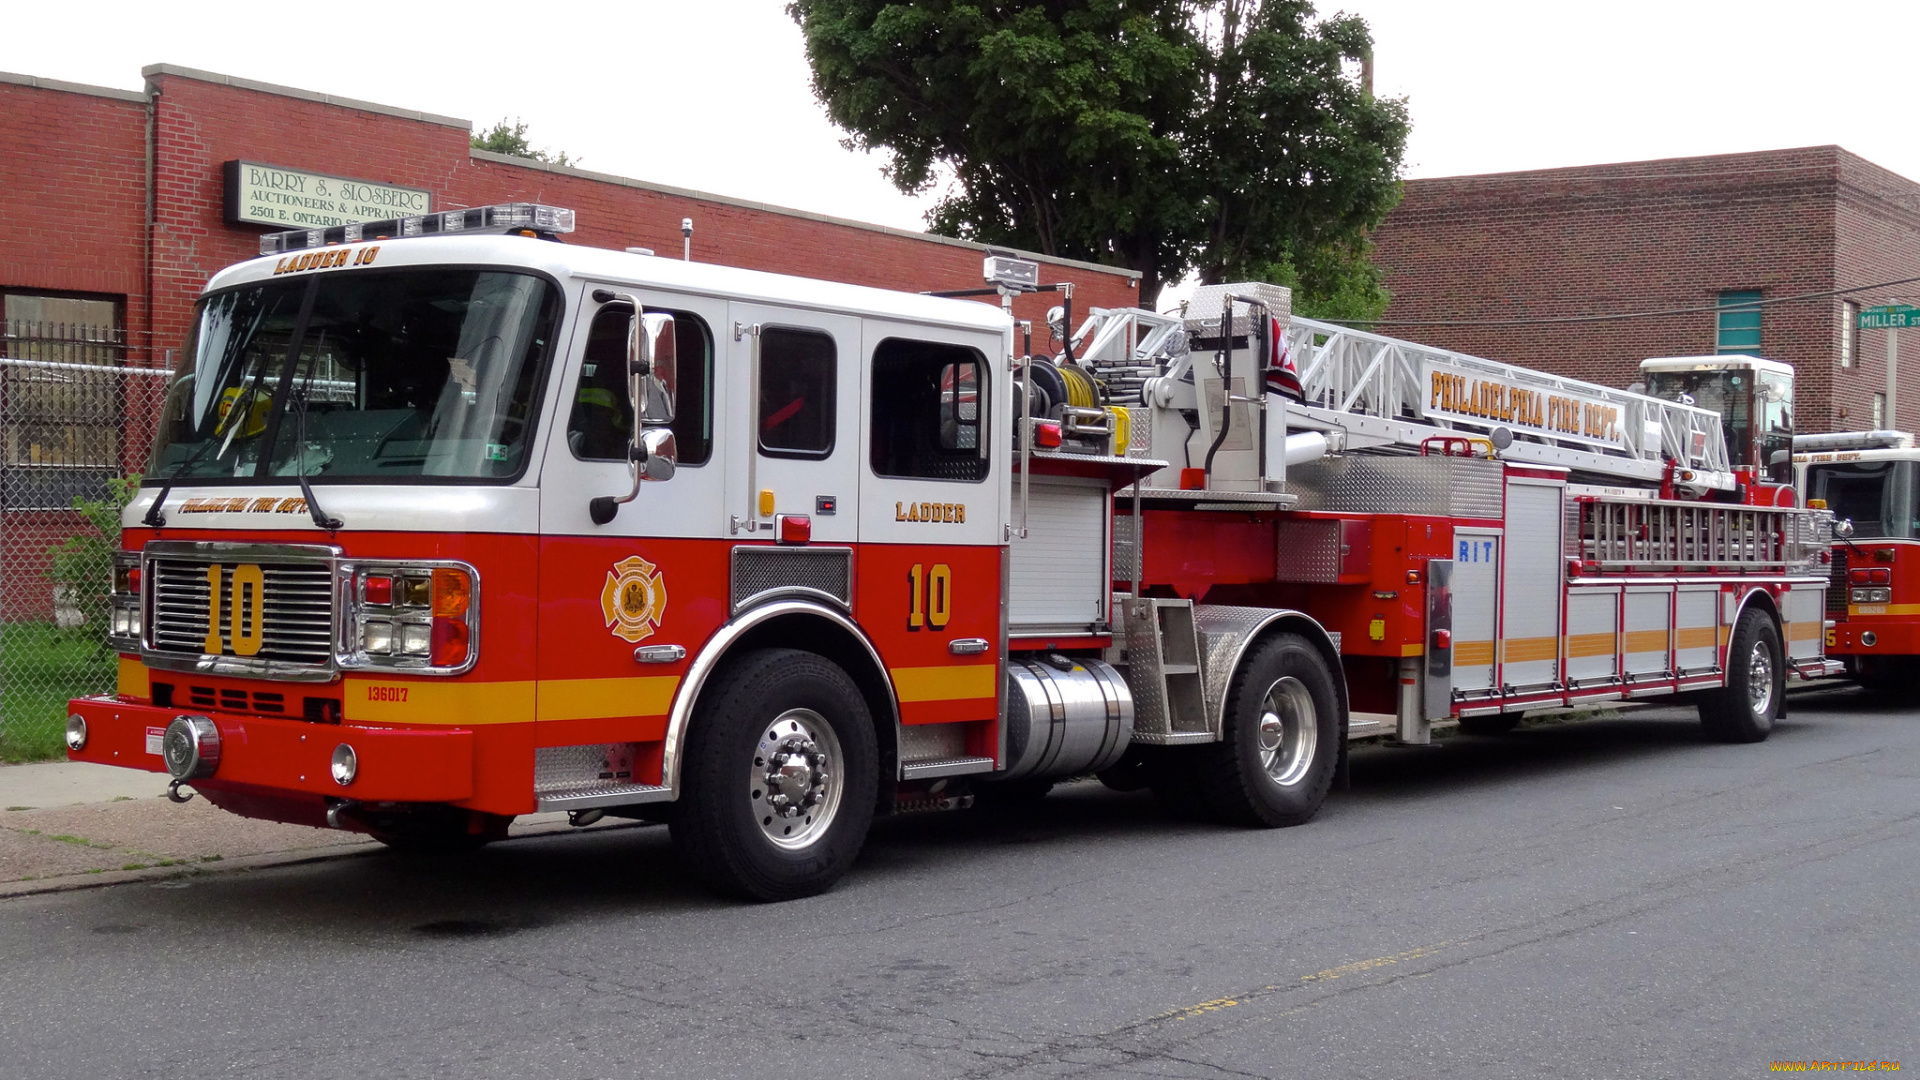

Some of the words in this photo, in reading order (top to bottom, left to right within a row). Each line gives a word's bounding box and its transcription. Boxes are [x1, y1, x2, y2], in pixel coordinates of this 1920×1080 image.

[250, 168, 307, 193] BARRY
[315, 179, 332, 197] S.
[340, 183, 424, 211] SLOSBERG
[250, 190, 335, 212] AUCTIONEERS
[338, 202, 348, 213] &
[250, 205, 275, 219] 2501
[279, 208, 289, 220] E.
[293, 211, 342, 226] ONTARIO
[273, 248, 352, 275] LADDER
[353, 246, 380, 266] 10
[1861, 314, 1906, 327] MILLER
[1431, 370, 1544, 428] PHILADELPHIA
[1548, 395, 1580, 435] FIRE
[1584, 402, 1621, 442] DEPT.
[178, 497, 251, 514] PHILADELPHIA
[247, 497, 283, 514] FIRE
[895, 502, 966, 523] LADDER
[1459, 541, 1492, 562] RIT
[907, 563, 951, 631] 10
[205, 564, 264, 656] 10
[1826, 629, 1836, 647] 5
[368, 686, 408, 702] 136017
